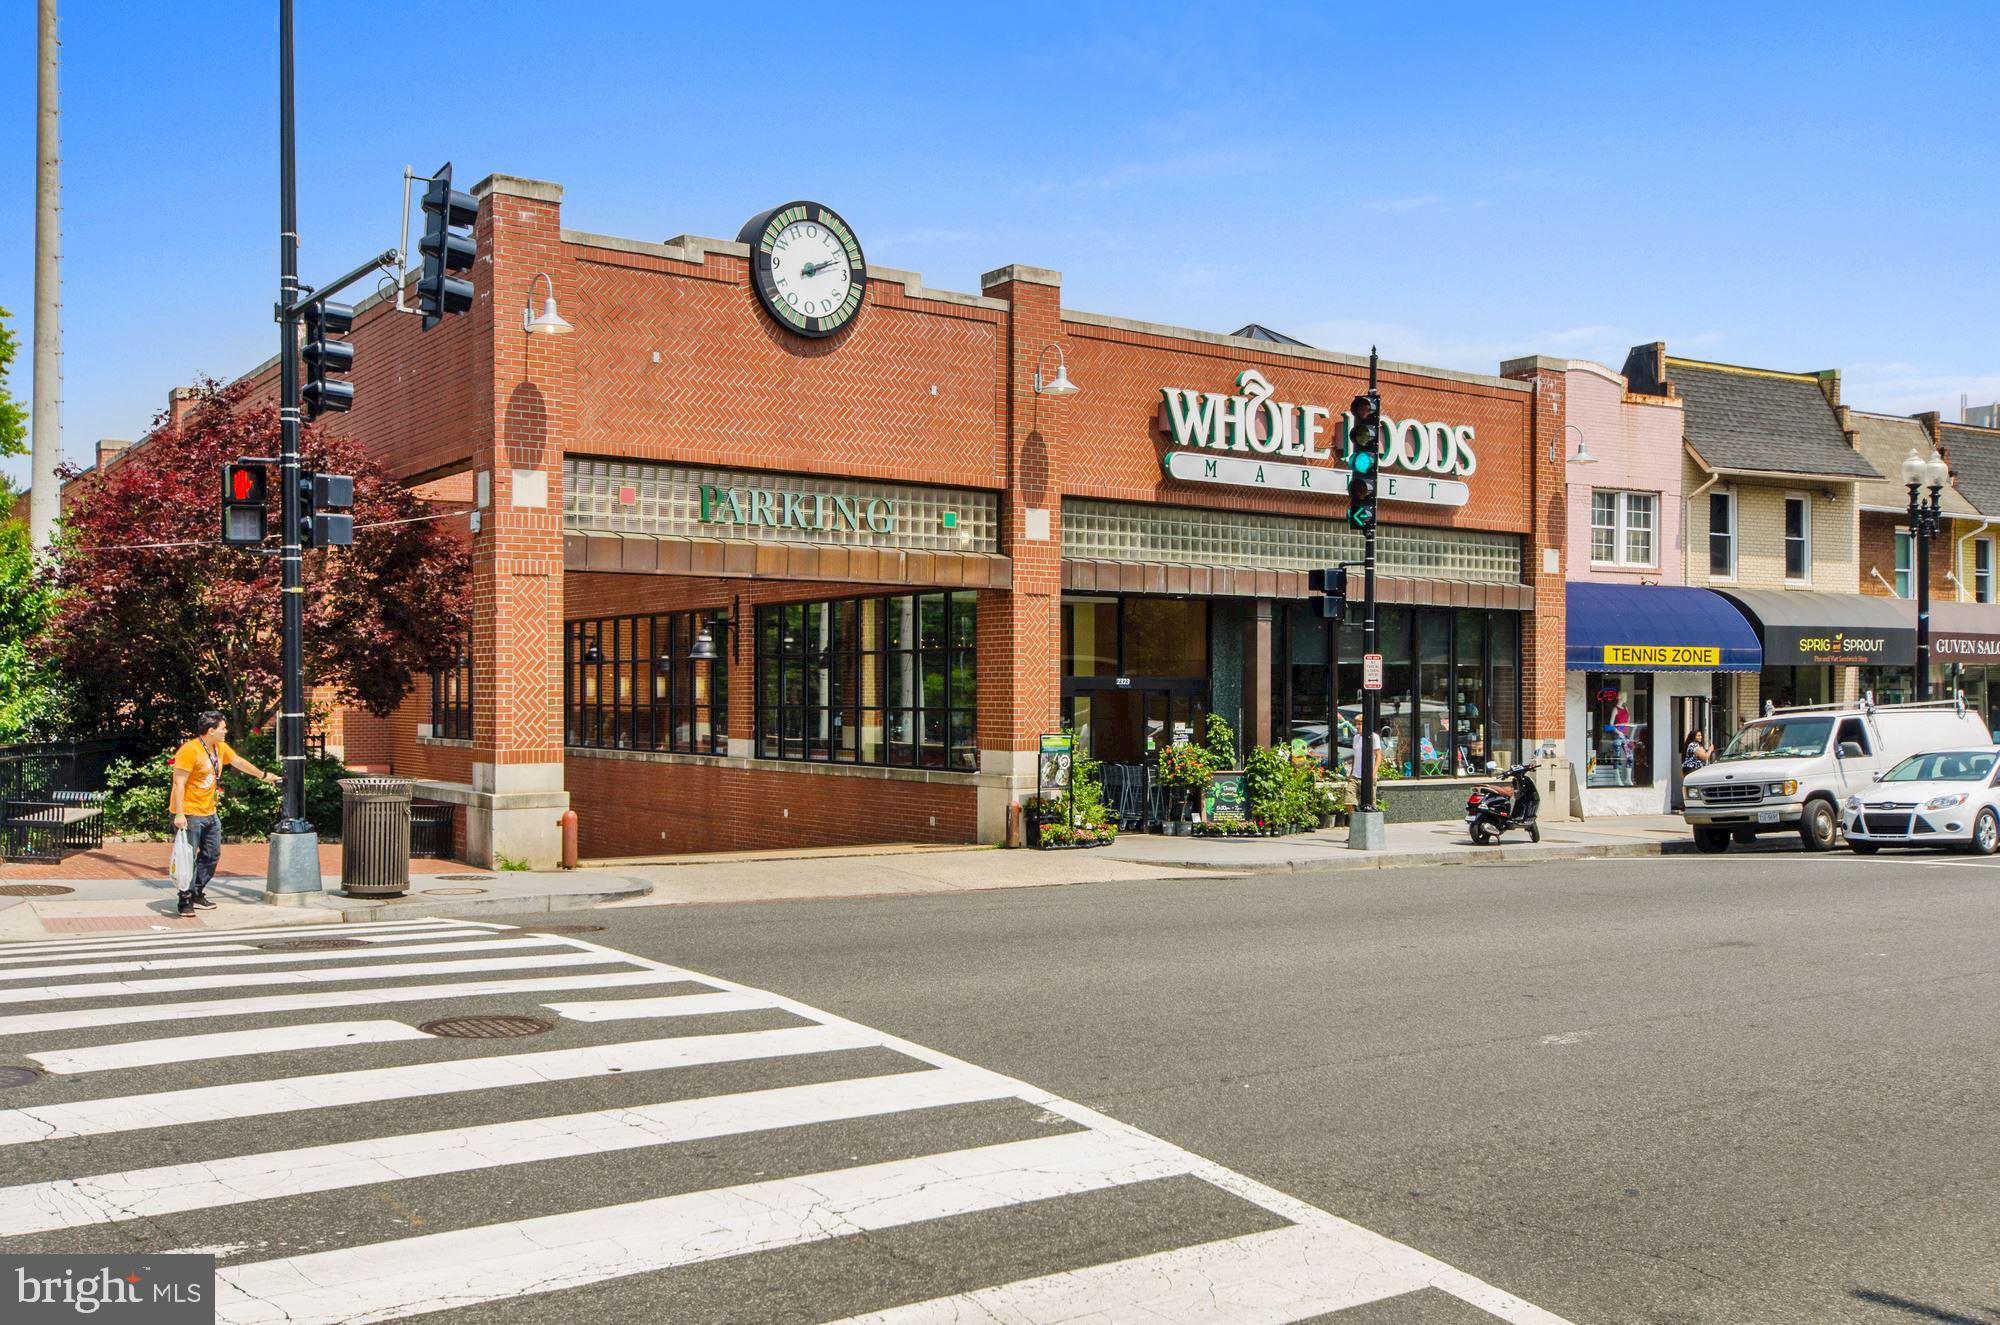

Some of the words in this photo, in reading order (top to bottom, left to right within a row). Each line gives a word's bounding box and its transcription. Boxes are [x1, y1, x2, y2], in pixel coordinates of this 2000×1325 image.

[776, 225, 844, 260] WHOLE
[773, 257, 780, 269] 9
[840, 269, 848, 281] 3
[776, 277, 842, 314] FOODS
[1160, 369, 1331, 459] WHOLE
[1341, 411, 1476, 476] OODS
[1204, 459, 1436, 499] MARET
[698, 484, 894, 534] PARKING
[1612, 647, 1667, 662] TENNIS
[1672, 649, 1712, 663] ZONE
[1799, 638, 1831, 652] SPRIG
[1843, 638, 1884, 652] SPROUT
[1936, 638, 1976, 654] GUVEN
